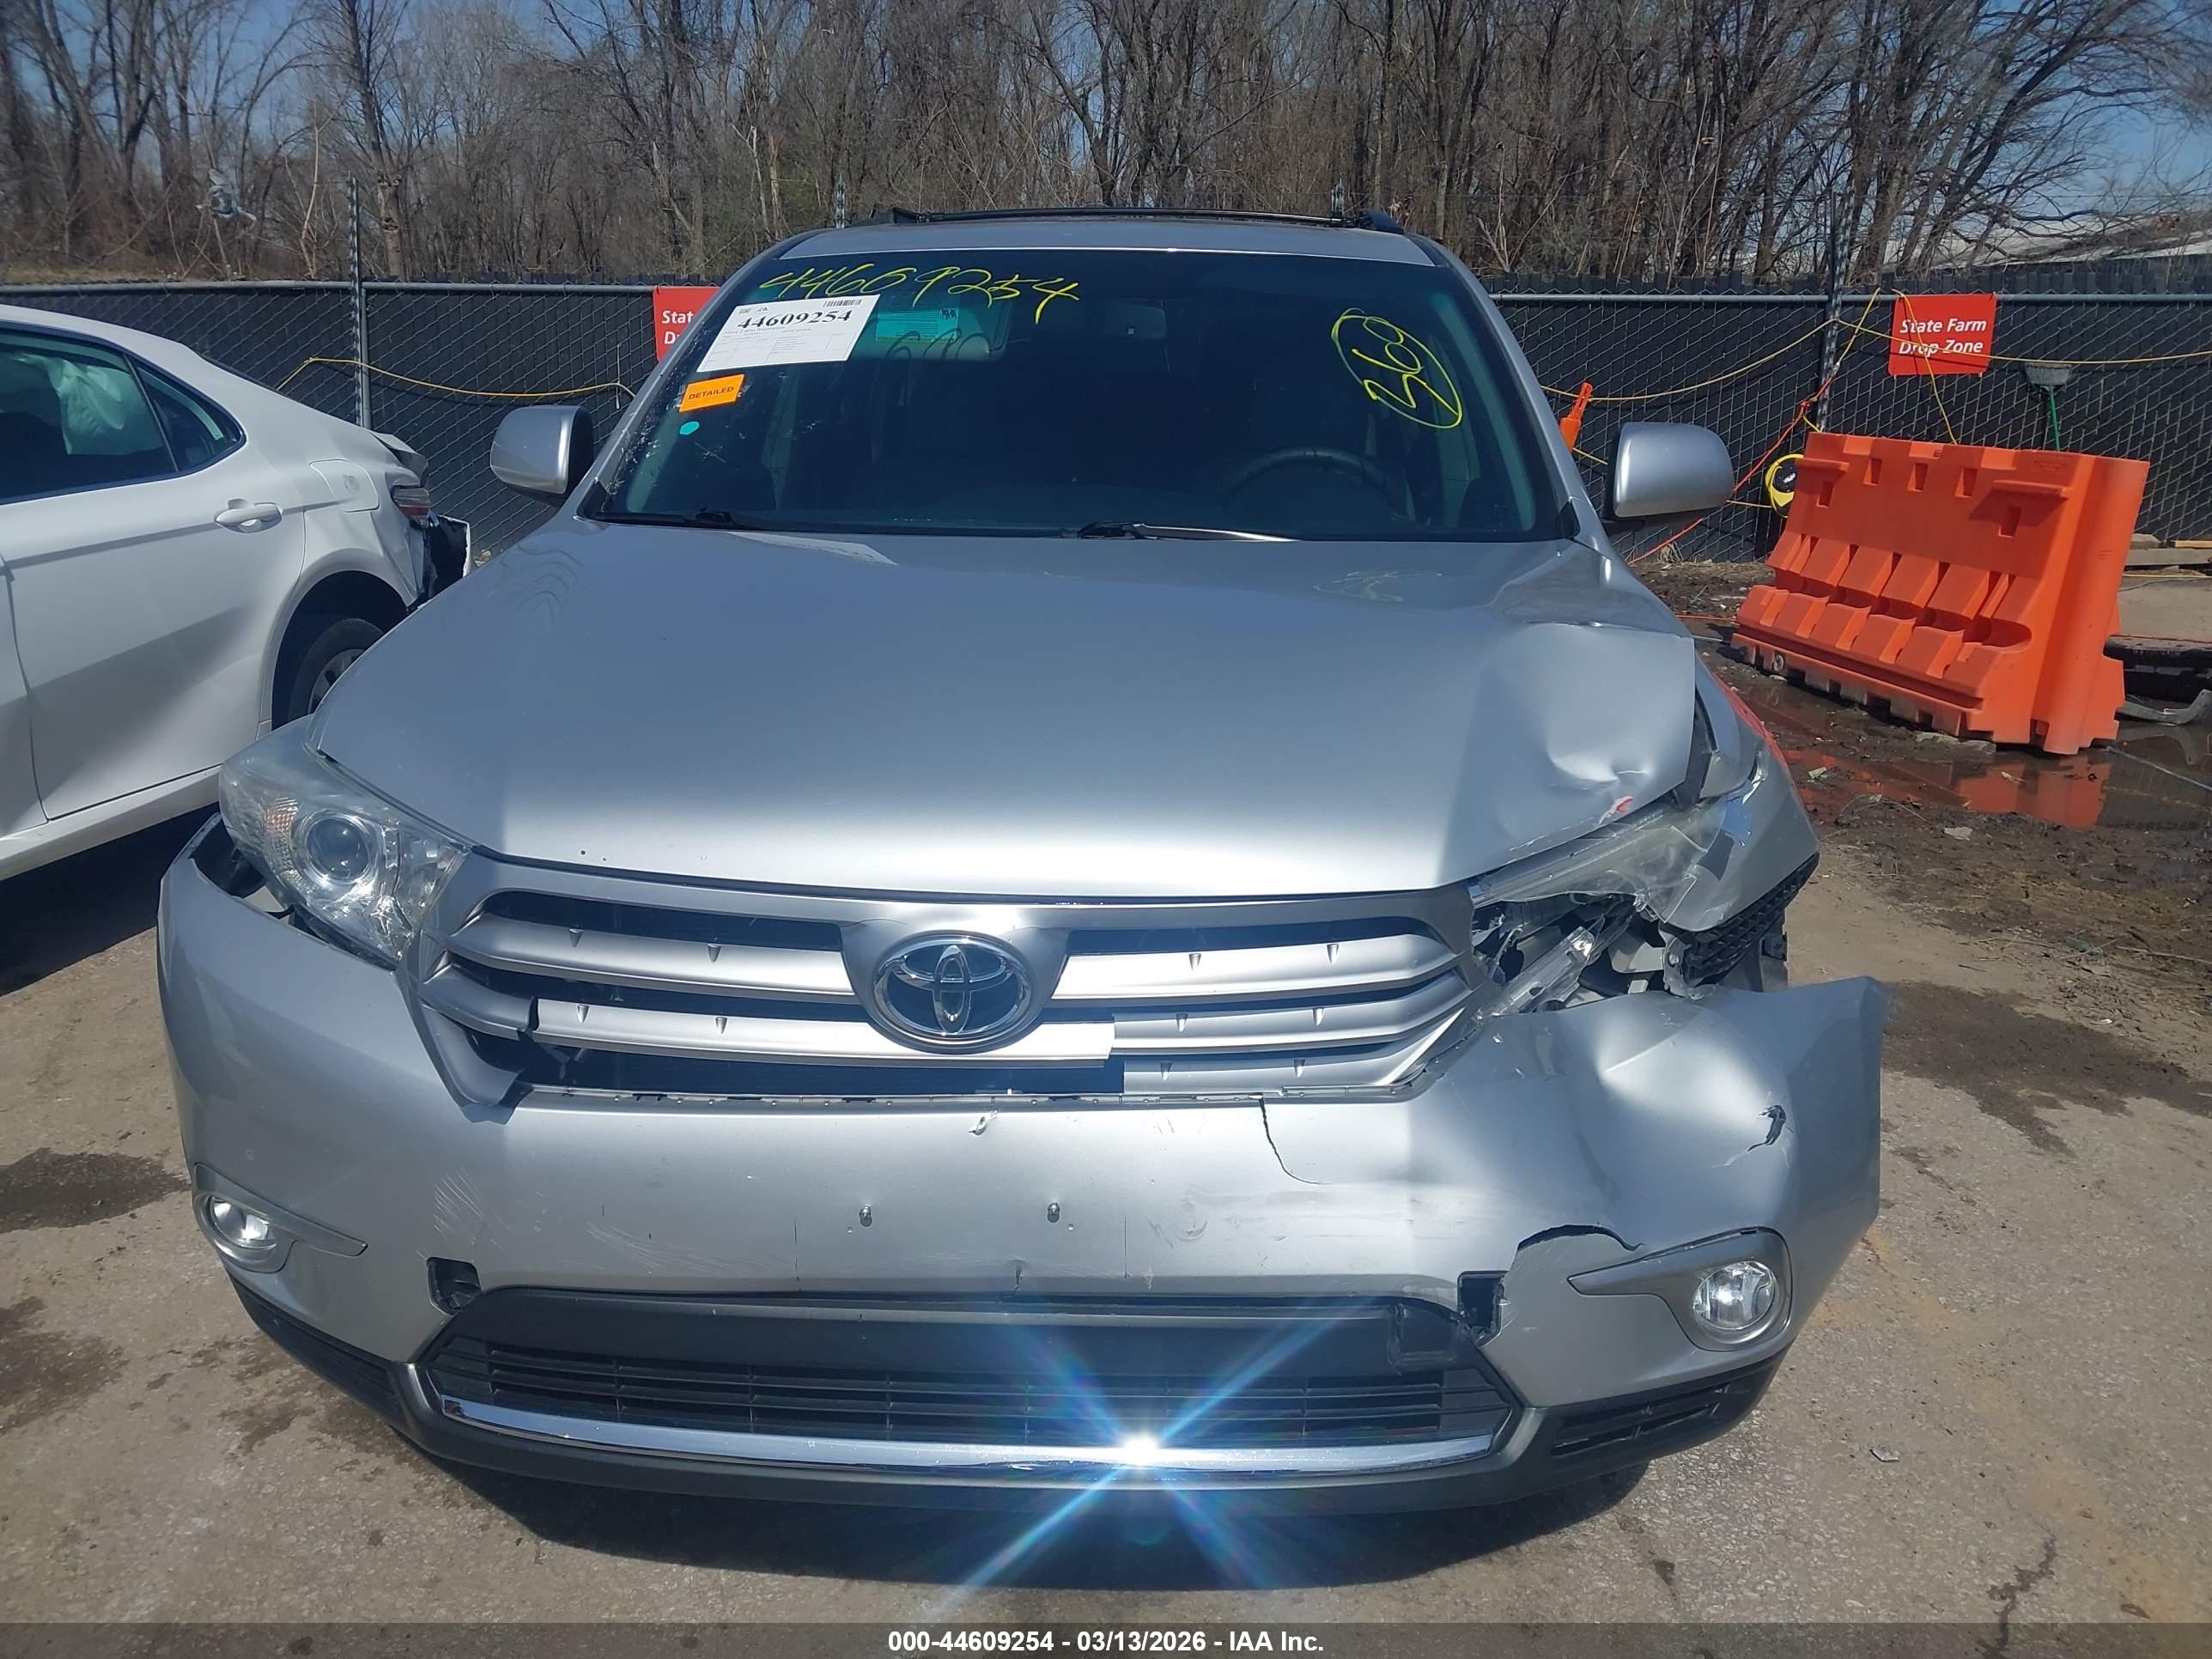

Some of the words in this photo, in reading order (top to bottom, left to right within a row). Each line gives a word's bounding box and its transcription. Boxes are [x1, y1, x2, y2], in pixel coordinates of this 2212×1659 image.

[759, 264, 1080, 325] 44609254
[661, 310, 694, 324] Stat
[738, 310, 852, 328] 44609254
[1899, 319, 1942, 333] State
[1947, 318, 1986, 331] Farm
[1899, 341, 1939, 357] Drop
[1942, 339, 1983, 353] Zone
[688, 386, 734, 400] DETAILED
